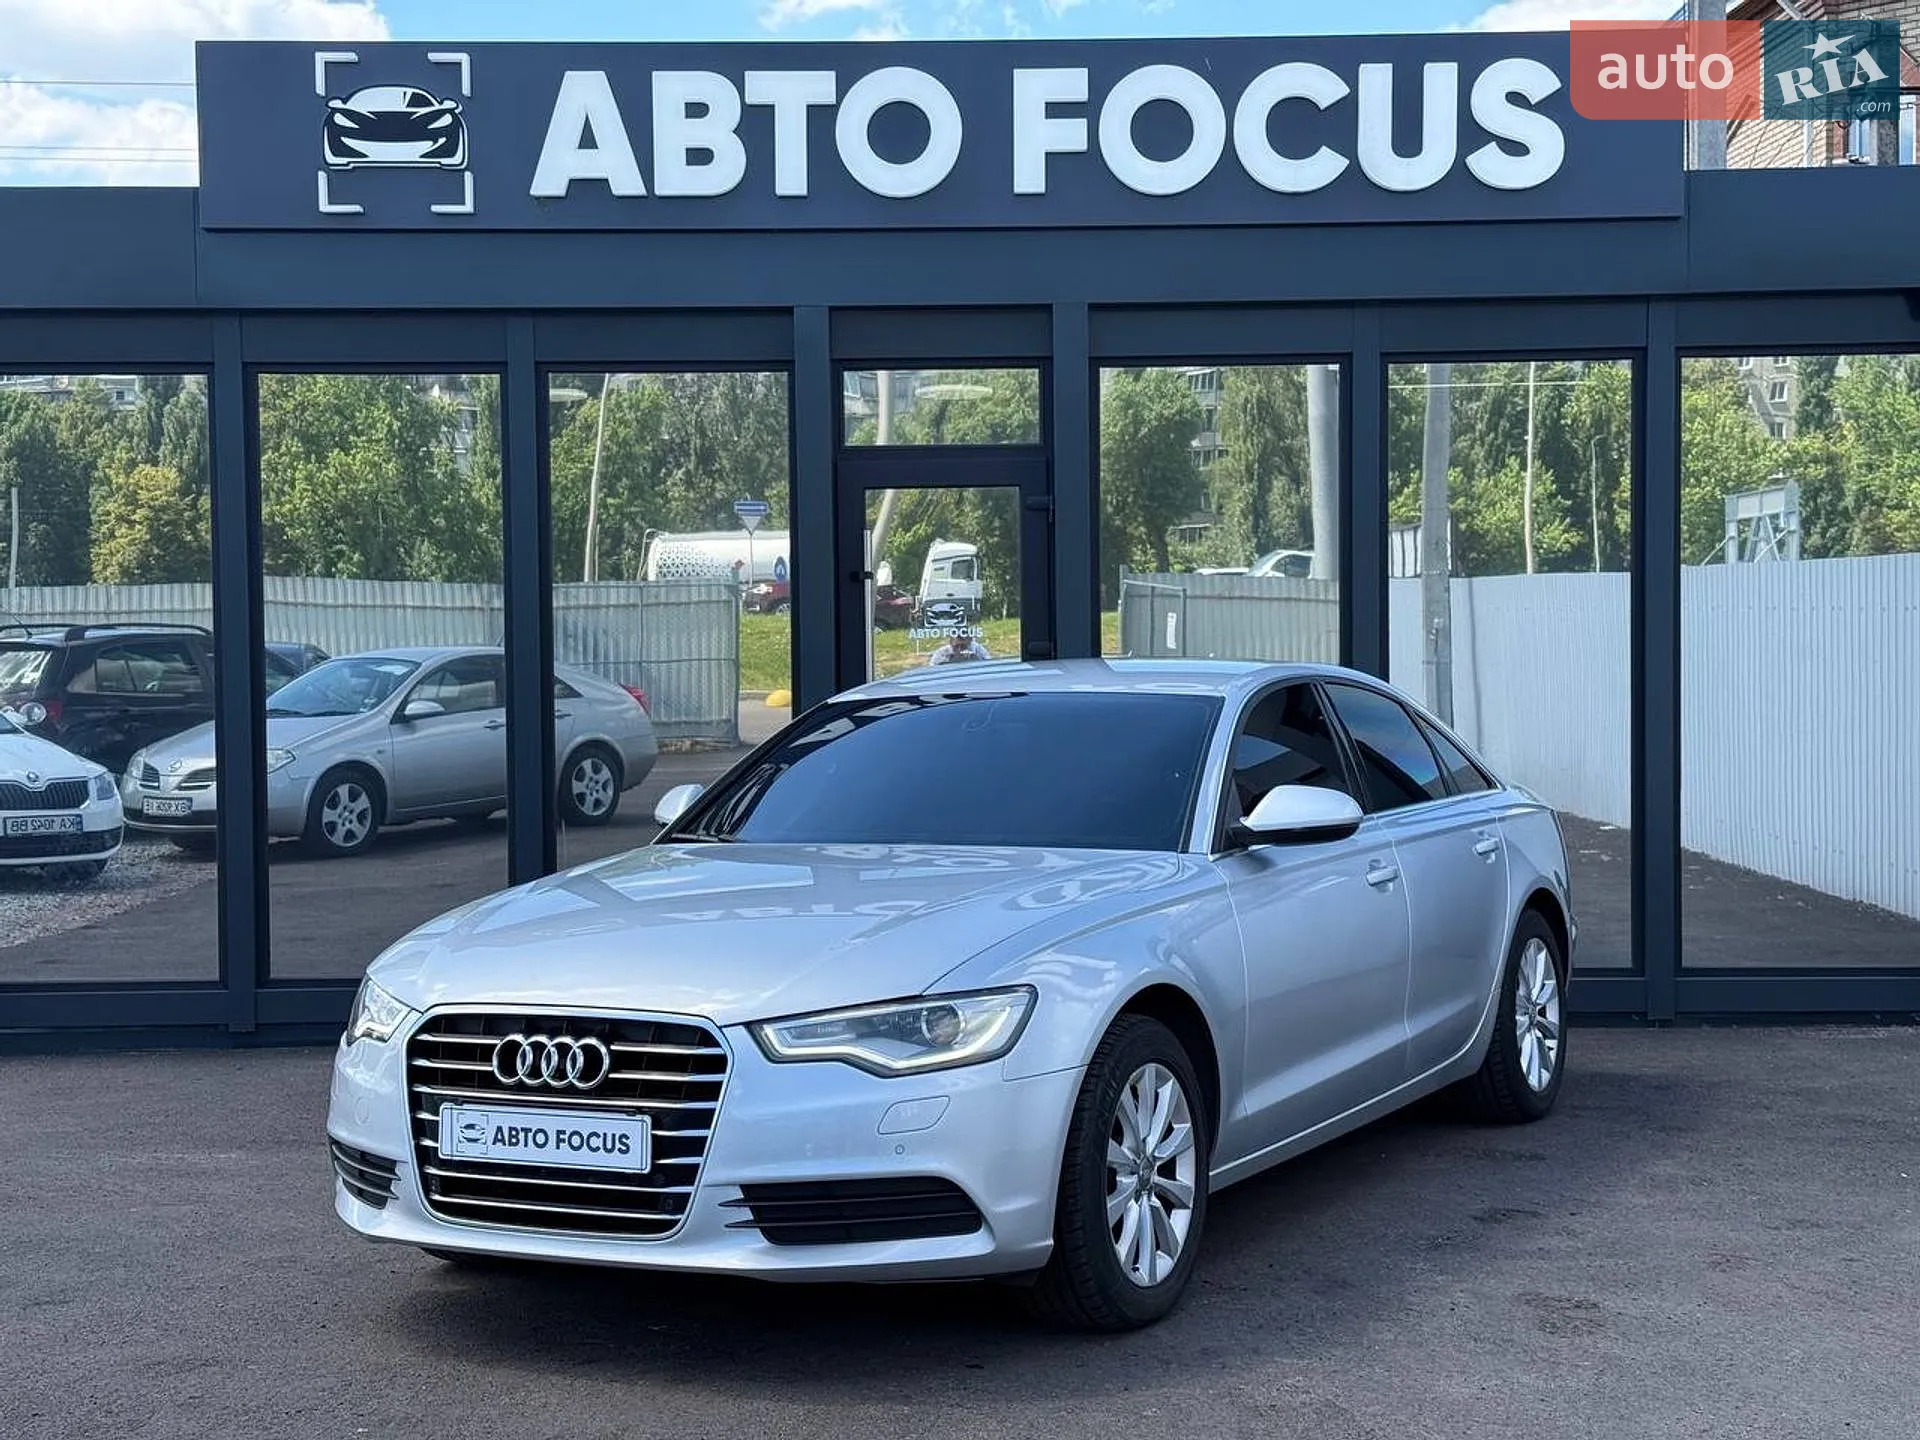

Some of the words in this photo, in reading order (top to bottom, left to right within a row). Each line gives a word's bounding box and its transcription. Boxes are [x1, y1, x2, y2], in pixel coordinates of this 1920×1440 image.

[529, 65, 964, 198] АВТО
[1012, 57, 1566, 196] FOCUS
[909, 627, 940, 639] АВТО
[943, 626, 984, 638] FOCUS
[492, 1125, 549, 1149] АВТО
[555, 1129, 631, 1155] FOCUS
